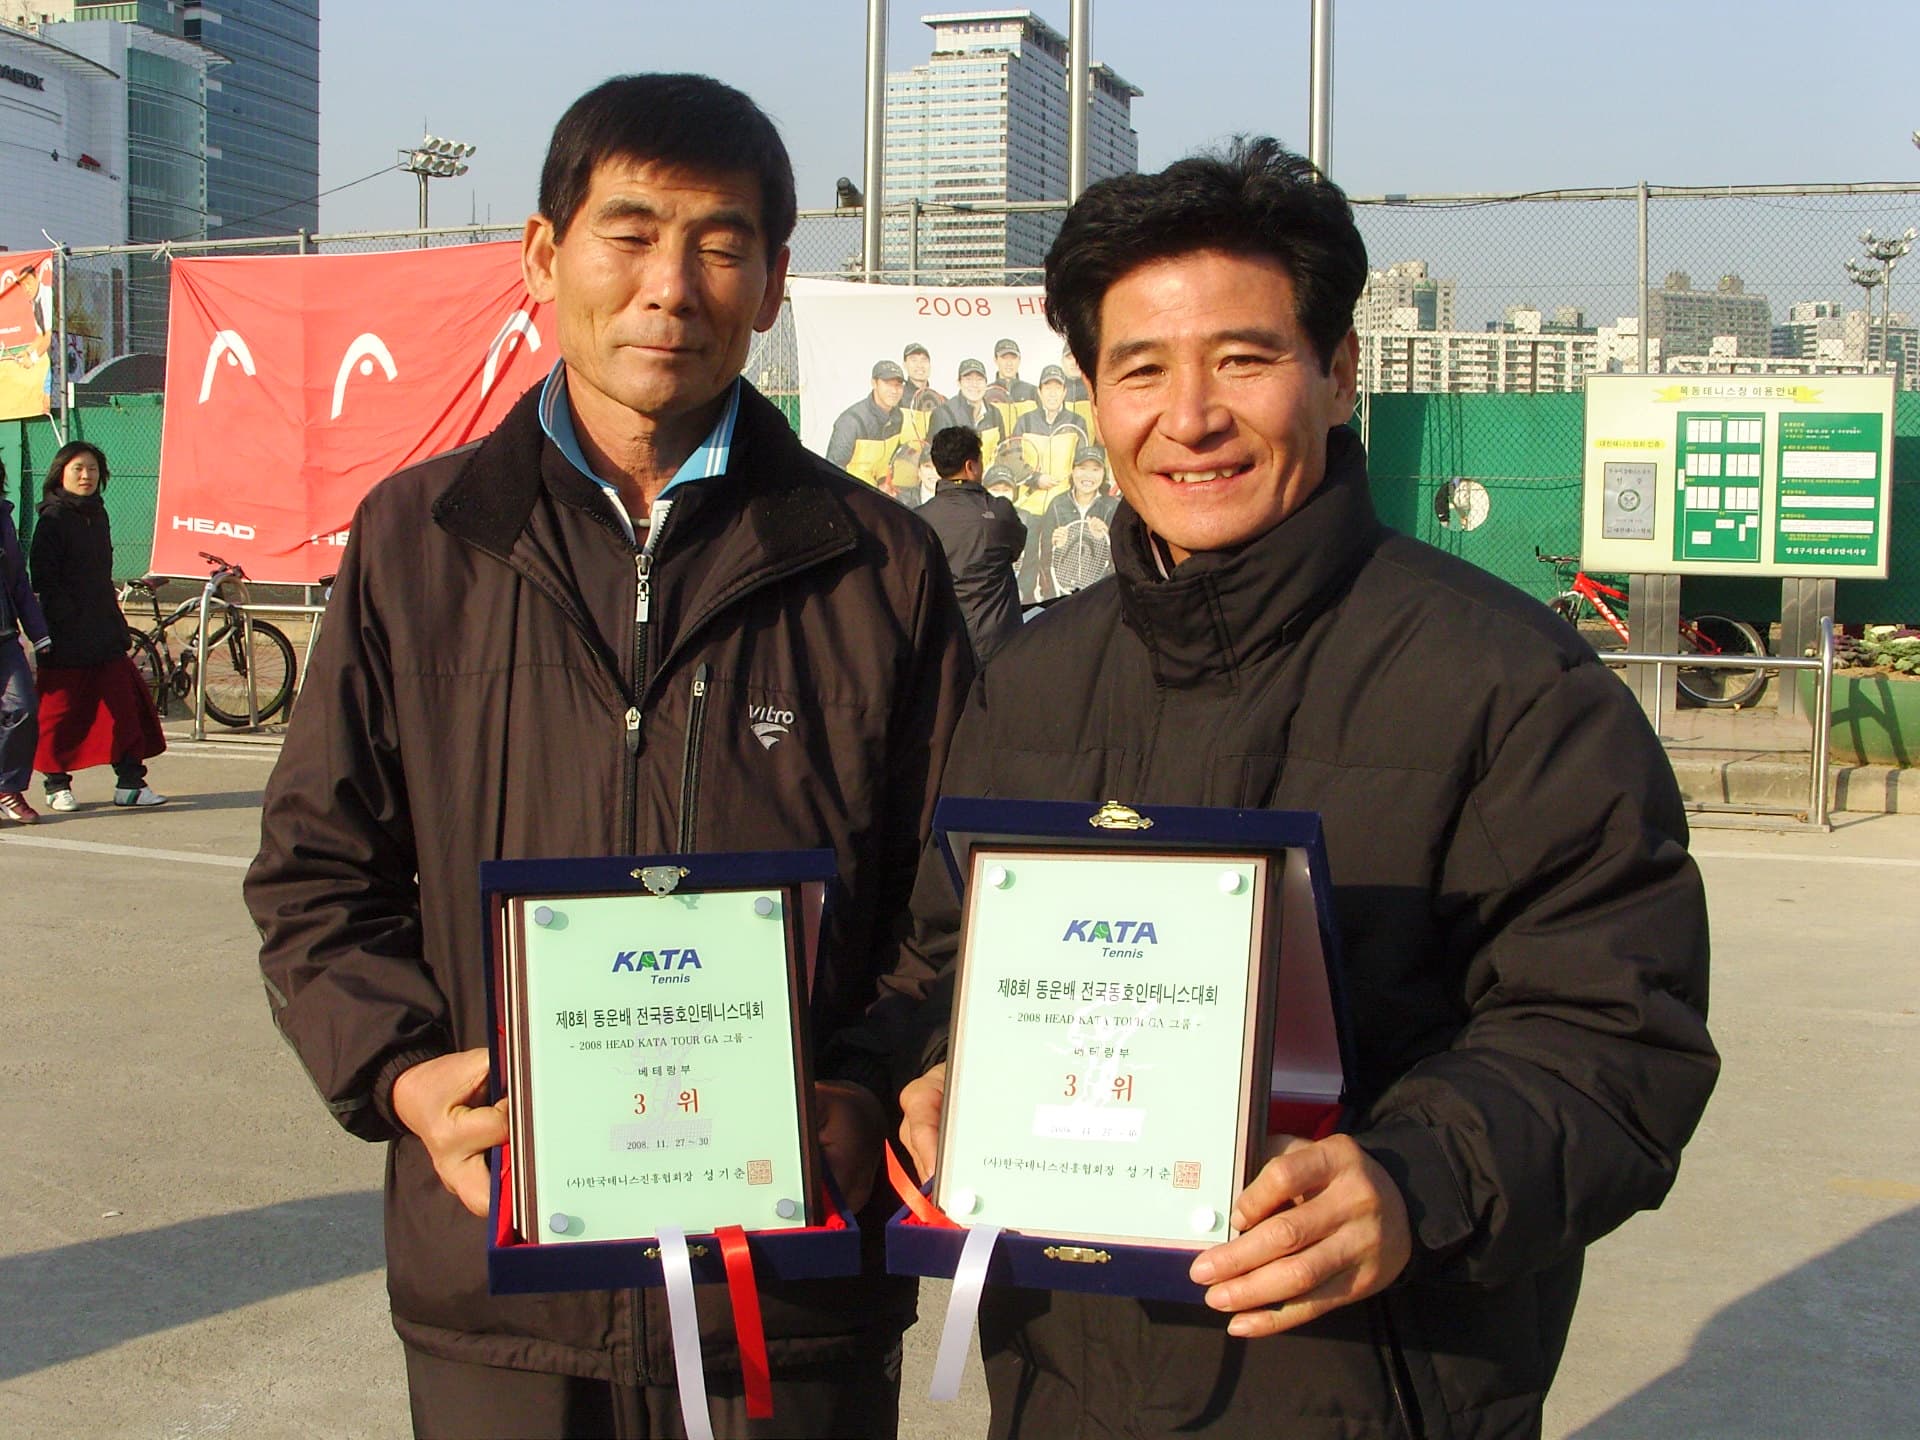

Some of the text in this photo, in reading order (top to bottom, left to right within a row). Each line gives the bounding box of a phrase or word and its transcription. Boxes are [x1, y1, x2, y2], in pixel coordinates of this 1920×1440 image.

[916, 296, 991, 317] 2008
[172, 515, 256, 540] HEAD
[1062, 919, 1158, 945] KATA
[612, 948, 702, 973] KATA
[1102, 947, 1144, 959] Tennis
[651, 974, 691, 985] Tennis
[997, 977, 1218, 1006] 제8회 동운배 전국동호인테니스대회
[555, 1000, 764, 1029] 제8회 동운배 전국동호인테니스대회
[1017, 1013, 1041, 1023] 2008
[1045, 1014, 1075, 1024] HEAD
[579, 1040, 602, 1051] 2008
[606, 1039, 634, 1050] HEAD
[638, 1037, 667, 1048] KATA
[671, 1035, 700, 1046] TOUR
[704, 1034, 719, 1044] GA
[1064, 1074, 1133, 1102] 3 위
[634, 1088, 699, 1115] 3 위
